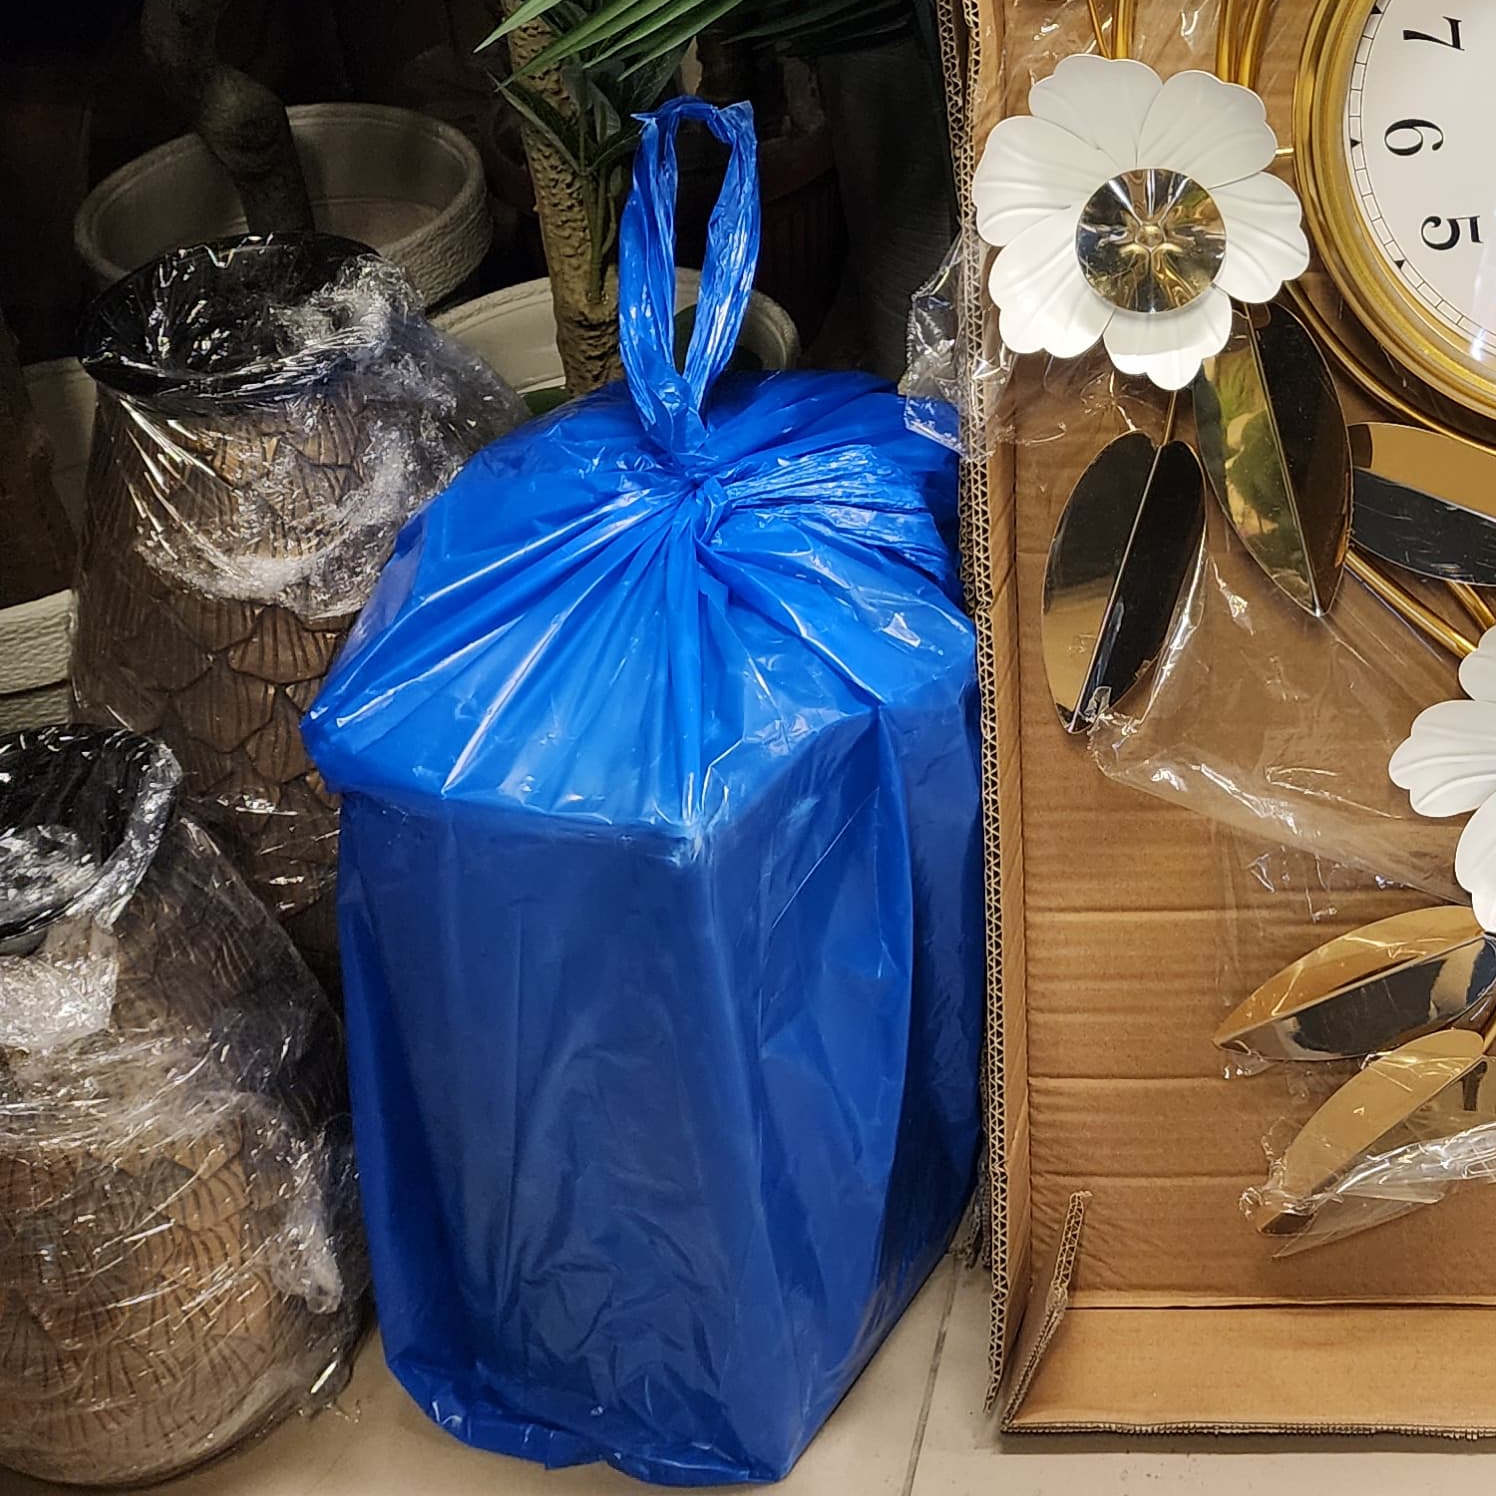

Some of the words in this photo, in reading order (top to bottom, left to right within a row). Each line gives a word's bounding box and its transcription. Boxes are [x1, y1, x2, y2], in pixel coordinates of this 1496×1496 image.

[1403, 16, 1465, 51] 7
[1384, 119, 1444, 156] 6
[1421, 215, 1484, 251] 5
